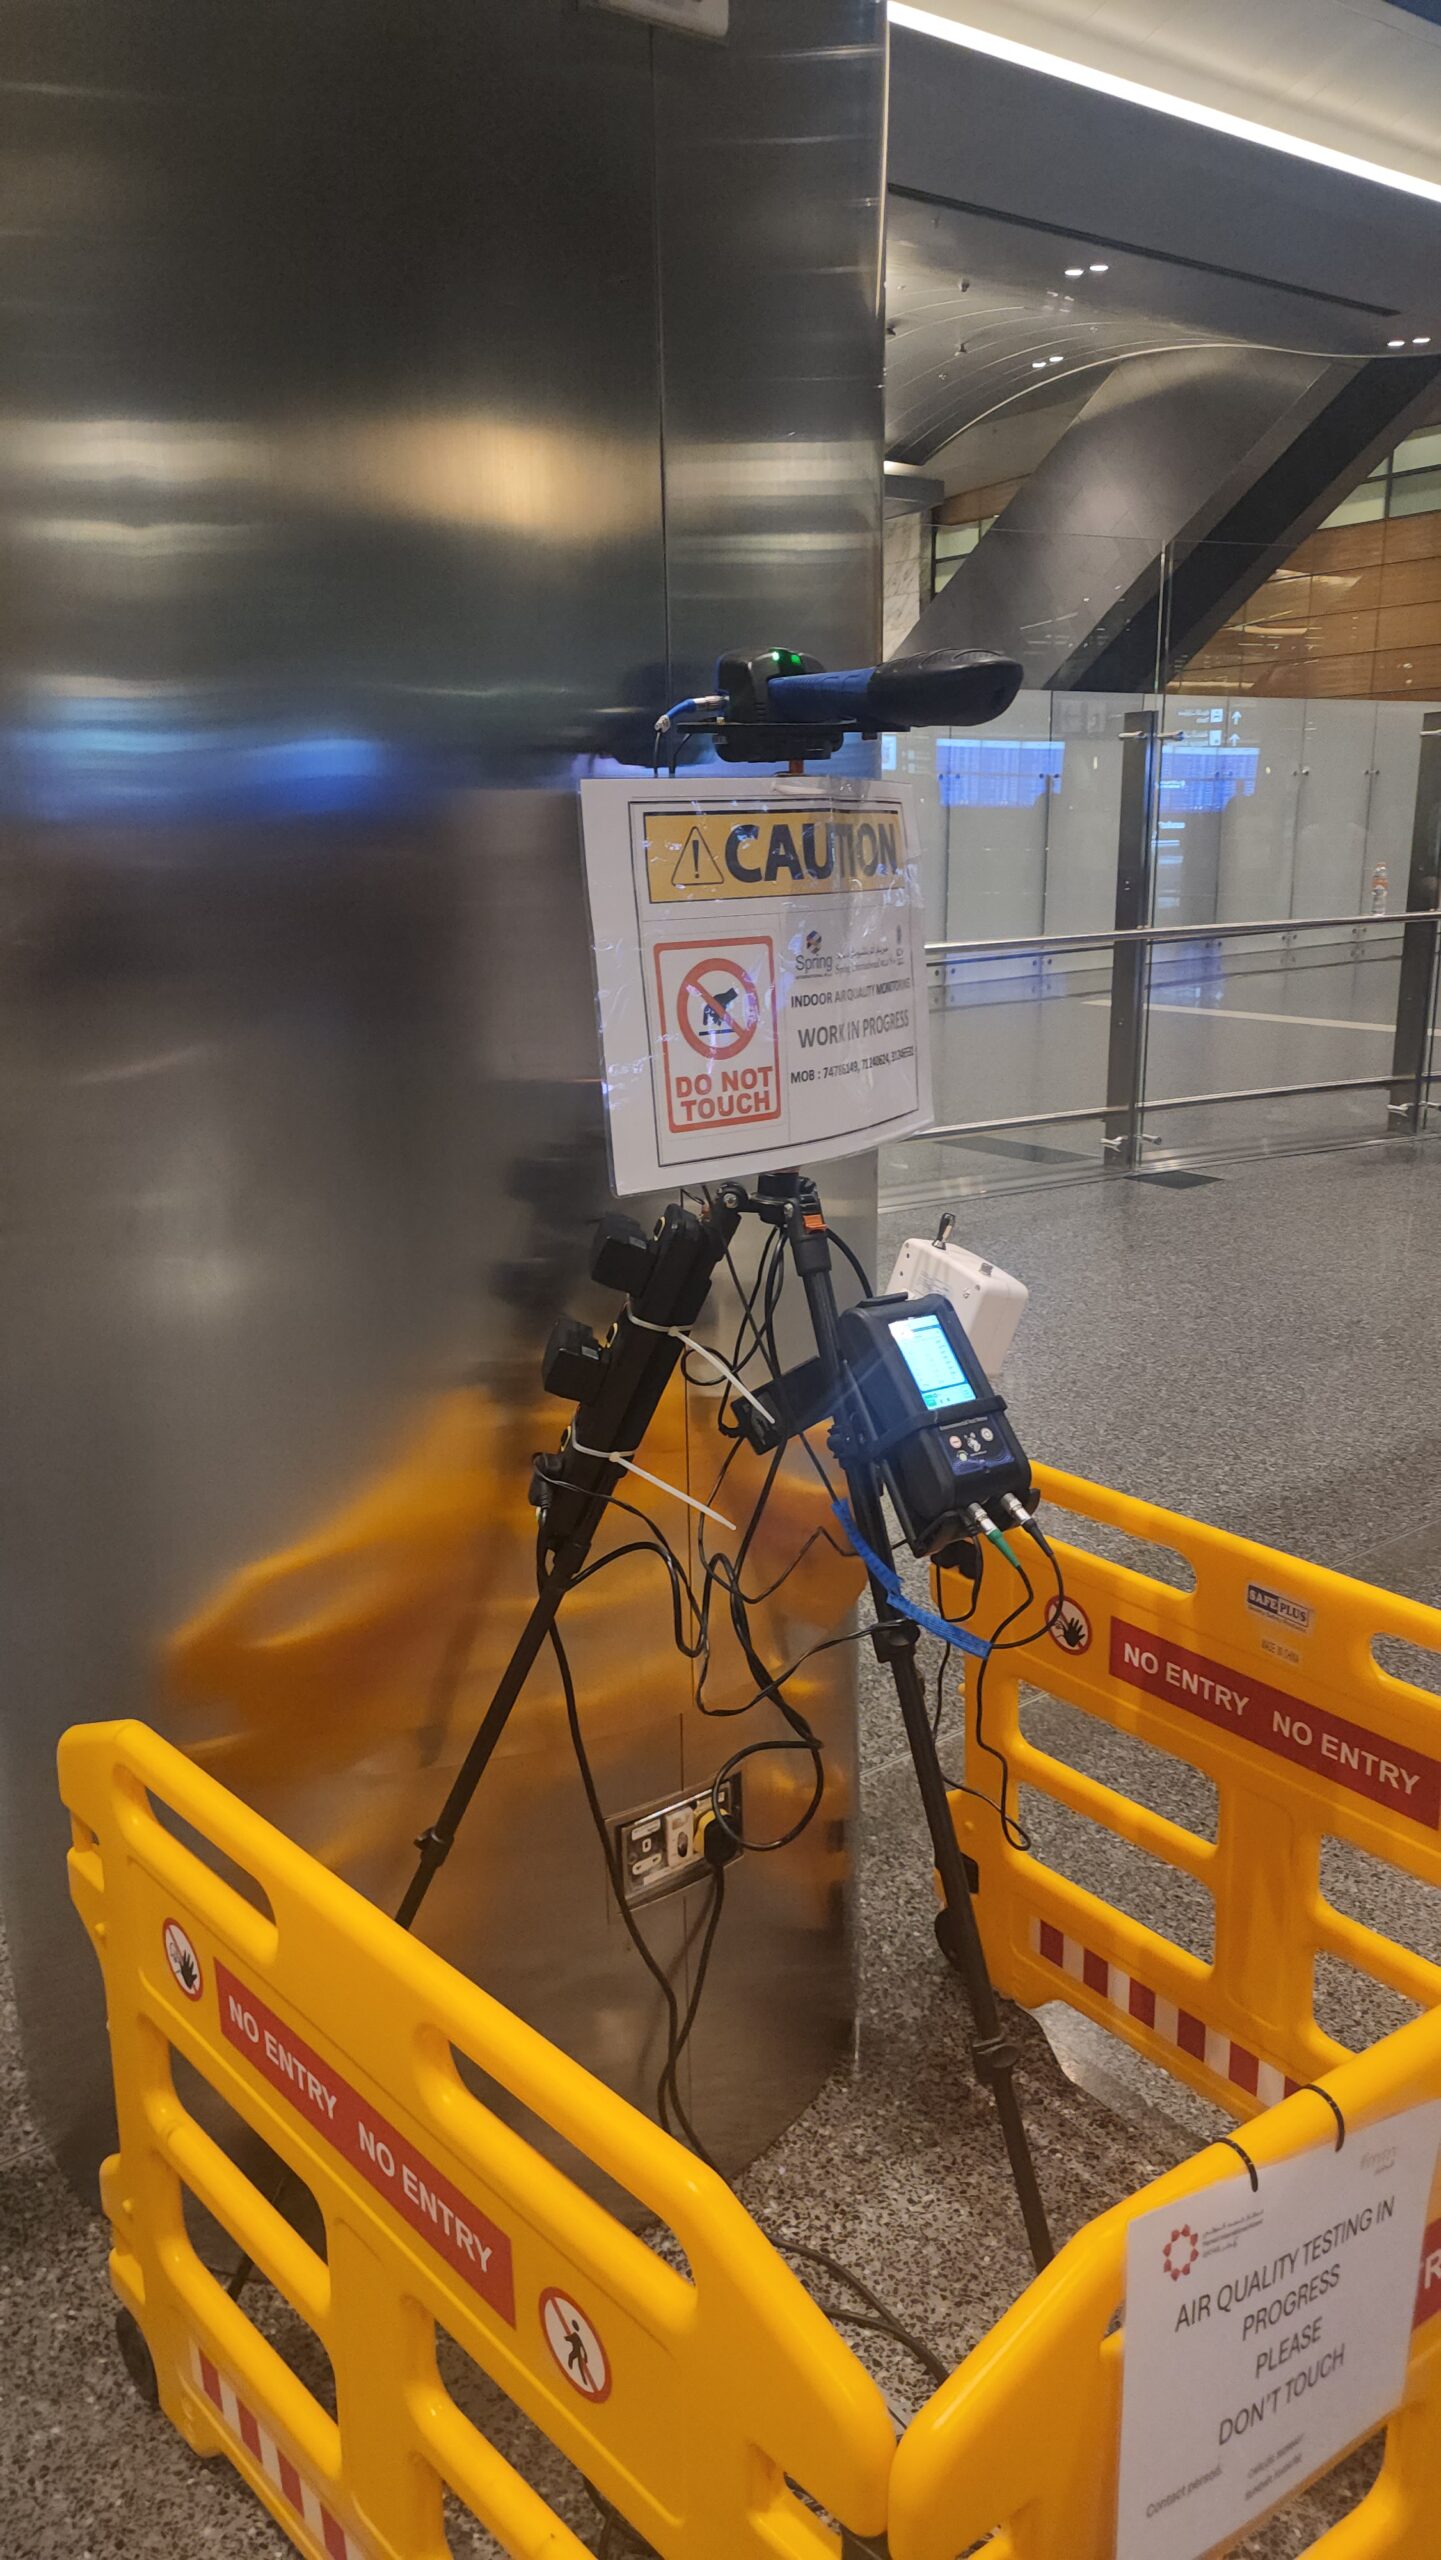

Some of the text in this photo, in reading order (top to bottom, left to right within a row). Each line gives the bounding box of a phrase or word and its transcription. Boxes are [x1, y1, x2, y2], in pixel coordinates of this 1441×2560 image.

[724, 822, 898, 883] CAUTION
[795, 954, 833, 974] Spring
[791, 991, 833, 1008] INDOOR
[798, 1009, 910, 1048] WORK IN PROGRESS
[675, 1066, 773, 1099] DO NOT
[791, 1069, 815, 1084] MOB
[681, 1090, 771, 1122] TOUCH
[1248, 1589, 1278, 1611] SAFE
[1279, 1602, 1306, 1622] PLUS
[1123, 1642, 1421, 1795] NO ENTRY NO ENTRY
[228, 1995, 493, 2273] NO ENTRY NO ENTRY
[1174, 2292, 1211, 2333] AIR
[1217, 2249, 1300, 2313] QUALITY
[1303, 2208, 1372, 2266] TESTING
[1376, 2195, 1395, 2223] IN
[1242, 2264, 1341, 2341] PROGRESS
[1254, 2316, 1324, 2379] PLEASE
[1218, 2343, 1346, 2446] DON'T TOUCH
